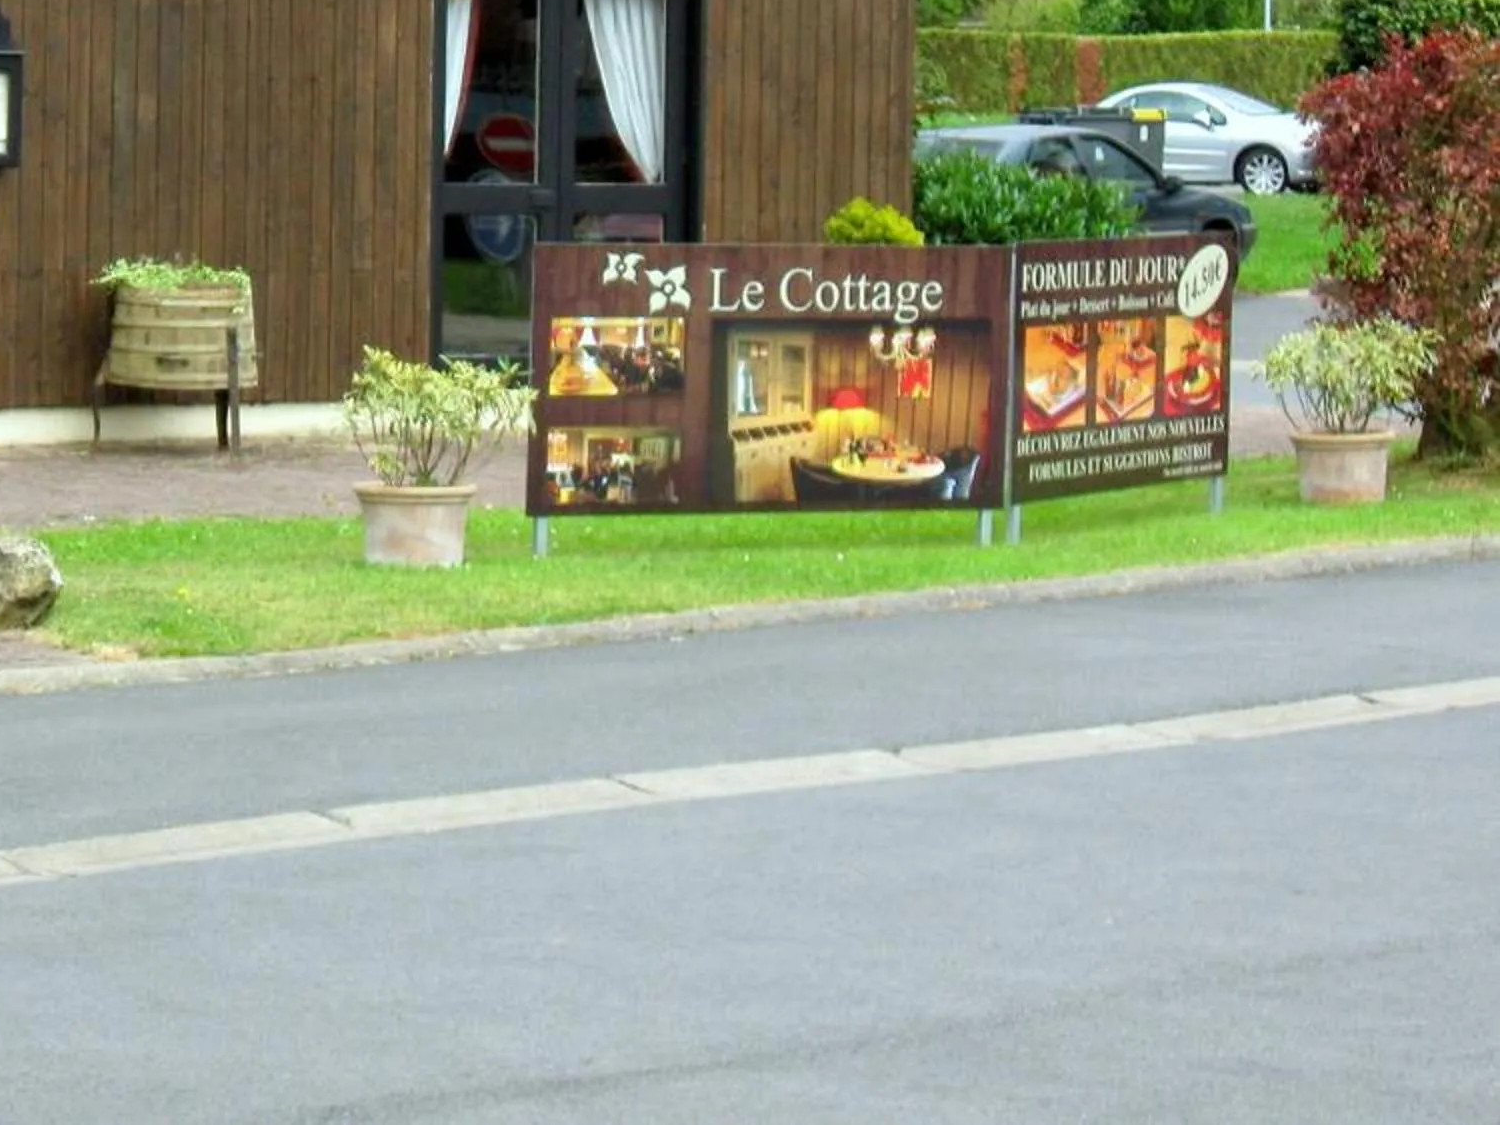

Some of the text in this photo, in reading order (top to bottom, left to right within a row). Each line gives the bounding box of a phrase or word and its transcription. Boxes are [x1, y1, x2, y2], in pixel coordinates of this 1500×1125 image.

[709, 266, 945, 324] Le Cottage
[1021, 261, 1107, 293] FORMULE
[1109, 257, 1132, 287] DU
[1029, 457, 1086, 483] FORMULES
[1087, 454, 1102, 474] ET
[1103, 446, 1171, 471] SUGGESTIONS
[1171, 442, 1213, 463] BISTROT
